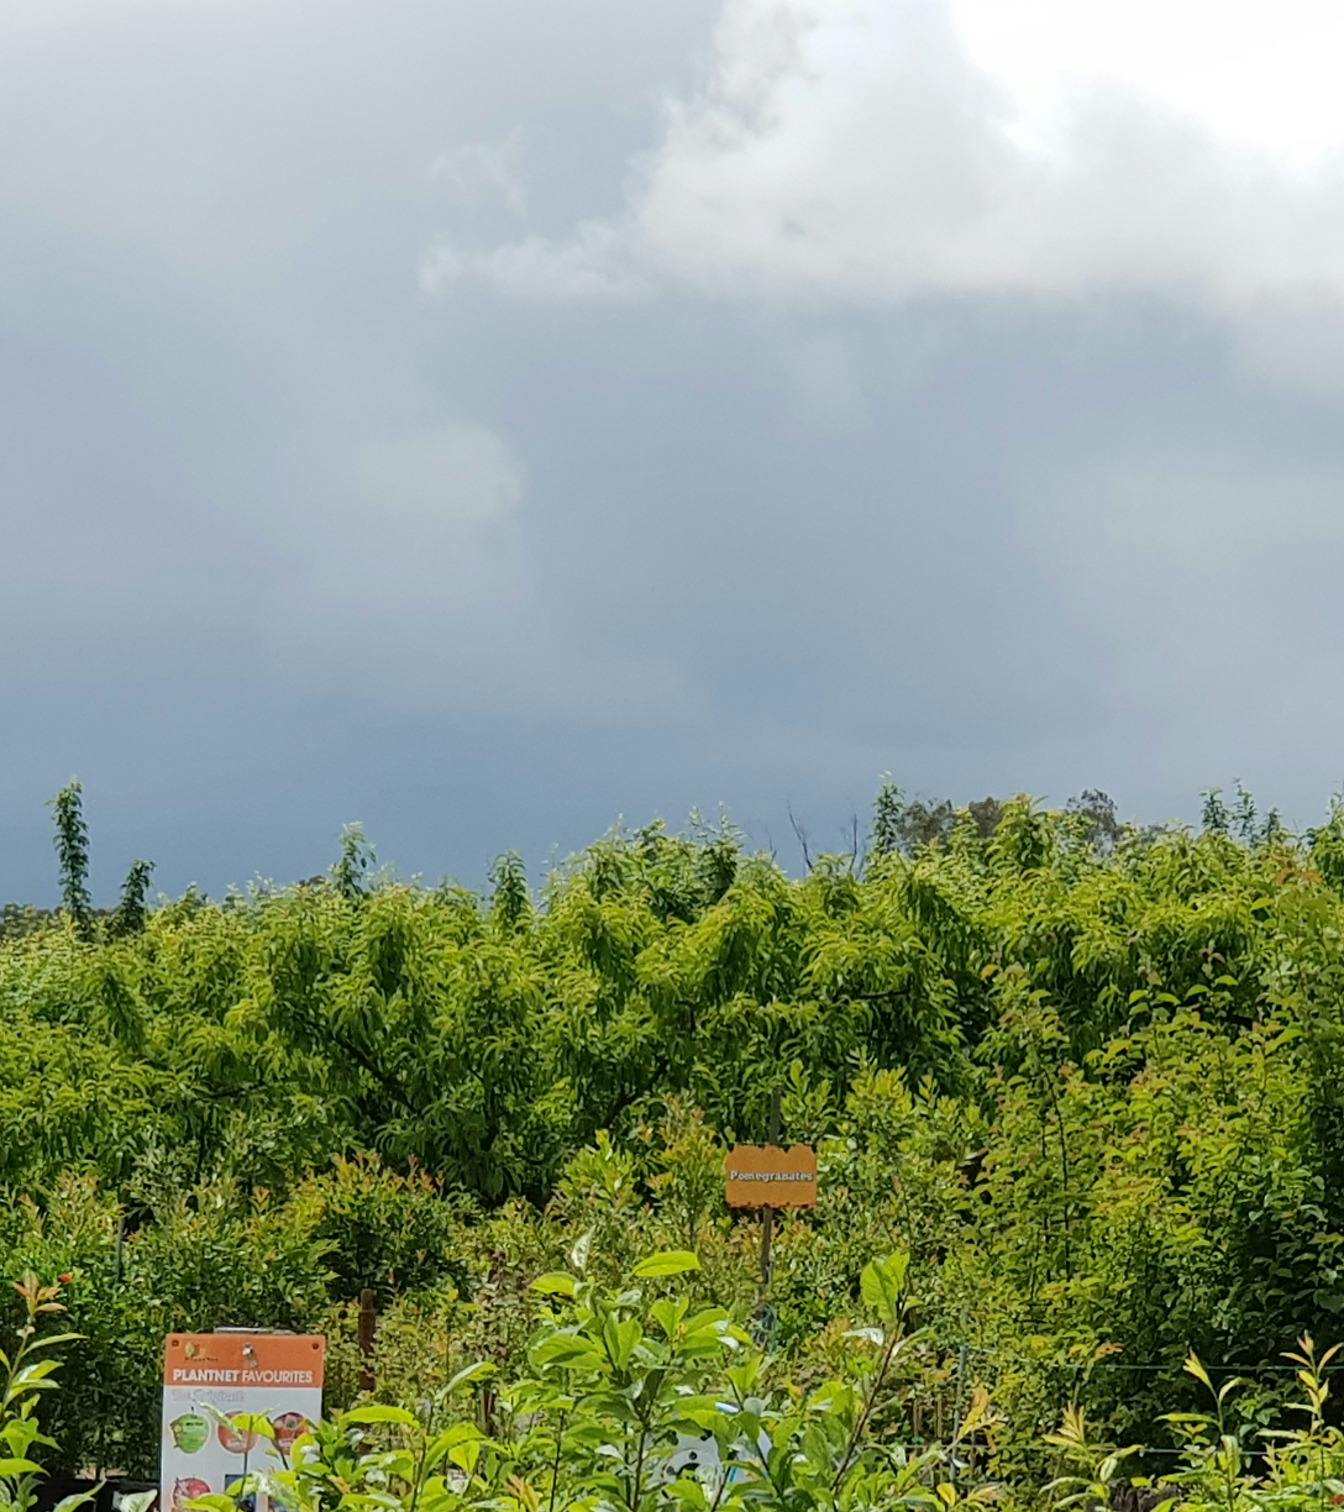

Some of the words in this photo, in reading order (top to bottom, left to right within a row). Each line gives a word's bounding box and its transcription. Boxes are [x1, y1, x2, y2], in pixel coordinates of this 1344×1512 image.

[730, 1171, 813, 1183] Pomegranates
[173, 1369, 239, 1382] PLANTNET
[242, 1370, 312, 1384] FAVOURITES
